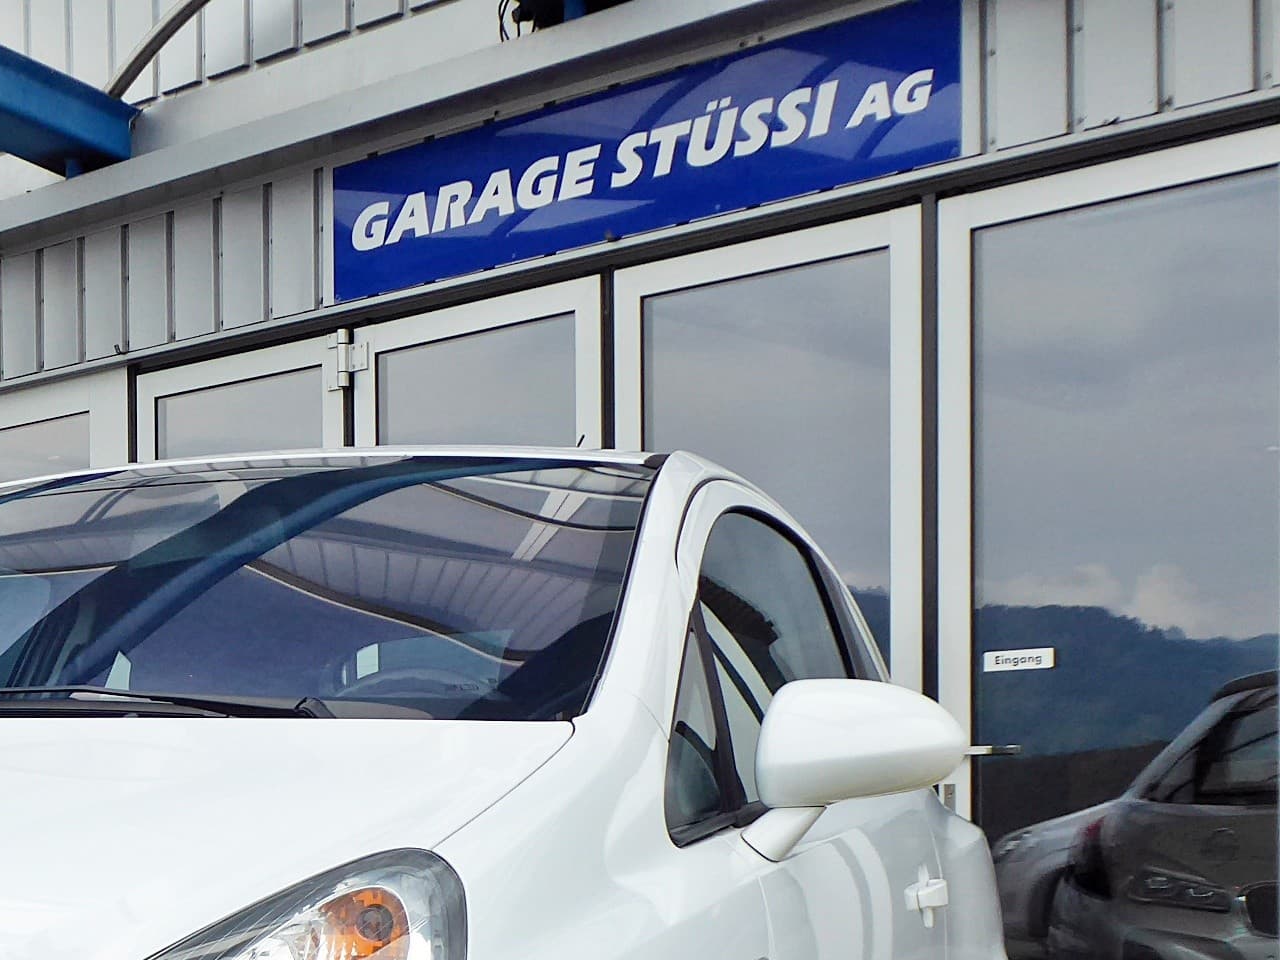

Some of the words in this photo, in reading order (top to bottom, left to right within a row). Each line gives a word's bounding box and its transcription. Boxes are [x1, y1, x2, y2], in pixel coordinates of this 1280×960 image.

[352, 146, 600, 252] GARAGE
[610, 80, 839, 188] STÜSSI
[845, 69, 934, 130] AG
[994, 655, 1042, 667] Eingang
